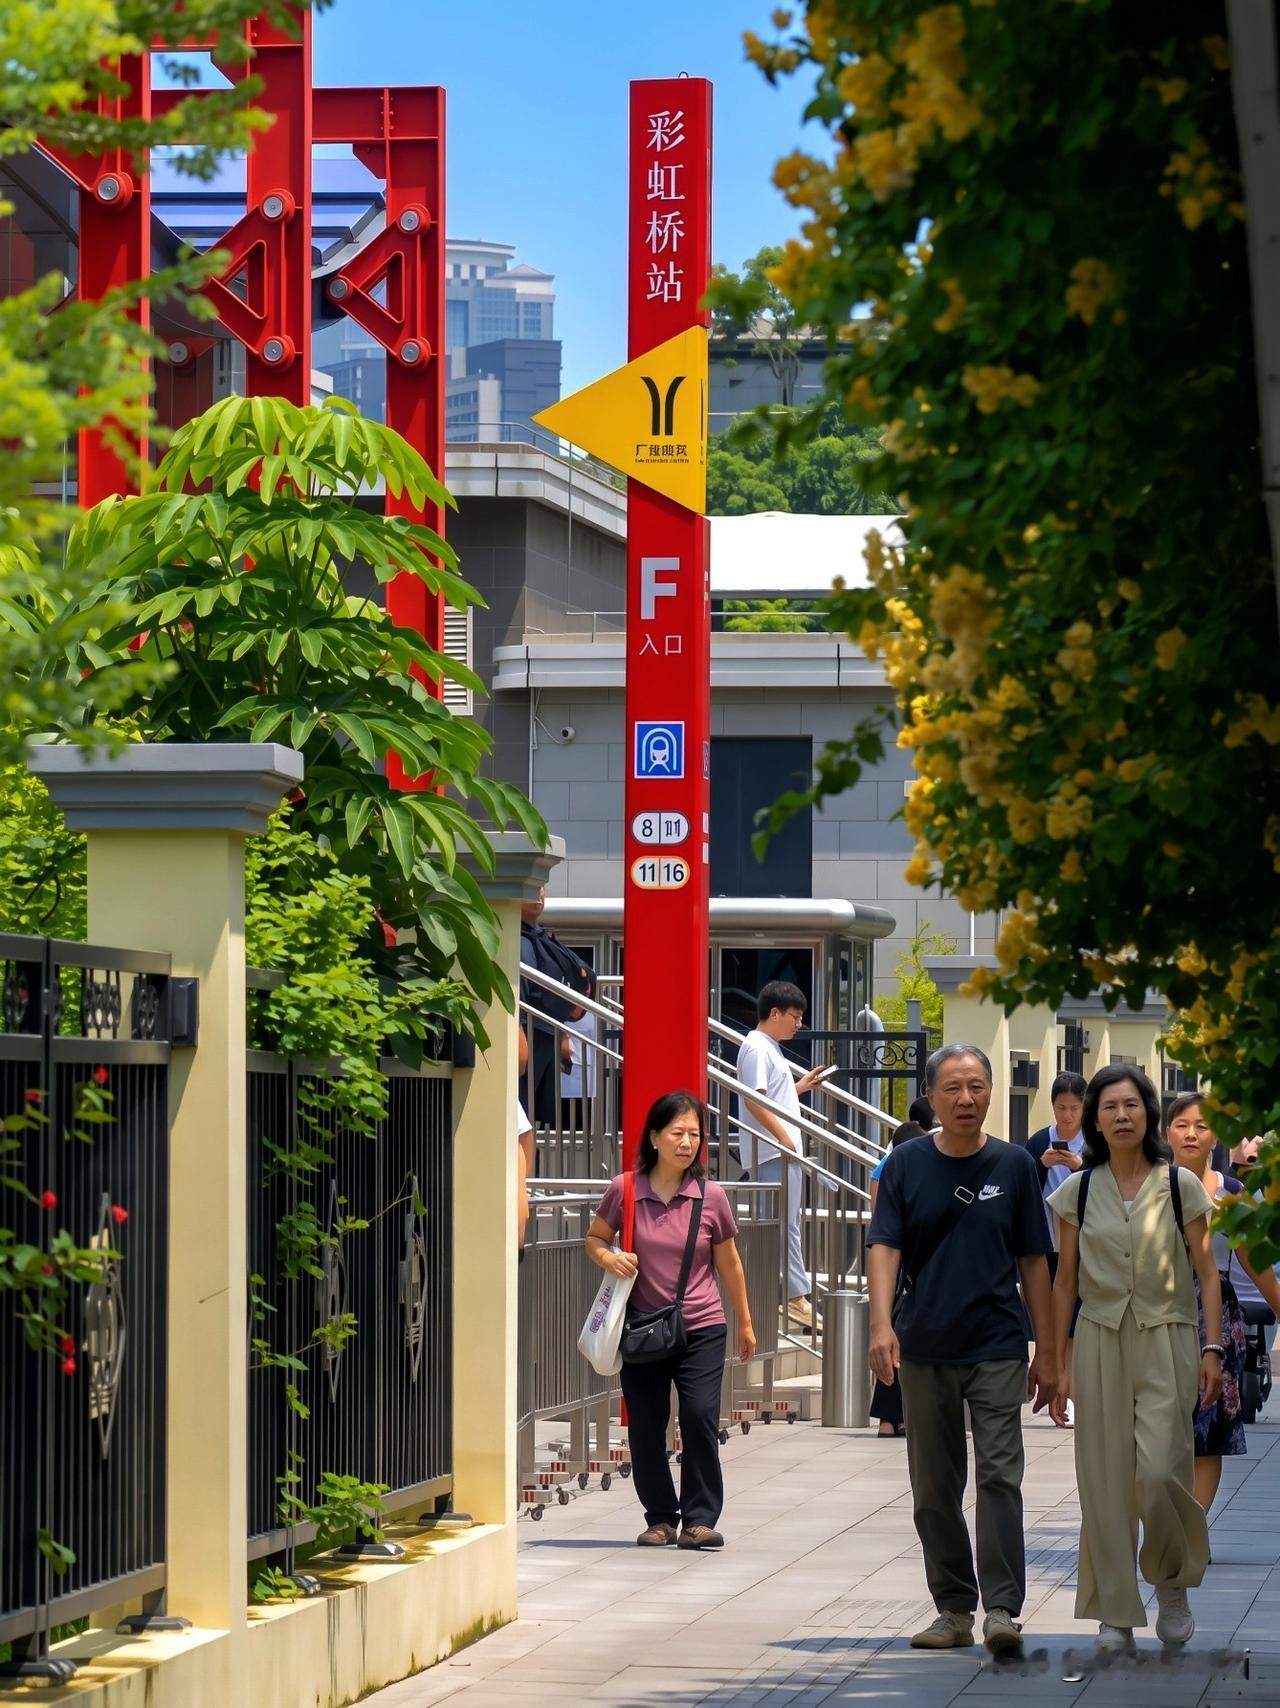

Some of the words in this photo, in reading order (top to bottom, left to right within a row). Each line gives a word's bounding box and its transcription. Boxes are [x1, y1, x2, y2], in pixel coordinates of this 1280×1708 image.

[645, 110, 686, 303] 彩虹桥站
[640, 557, 681, 620] F
[639, 633, 682, 656] 入口
[641, 818, 653, 838] 8
[639, 863, 655, 882] 11
[663, 863, 685, 882] 16
